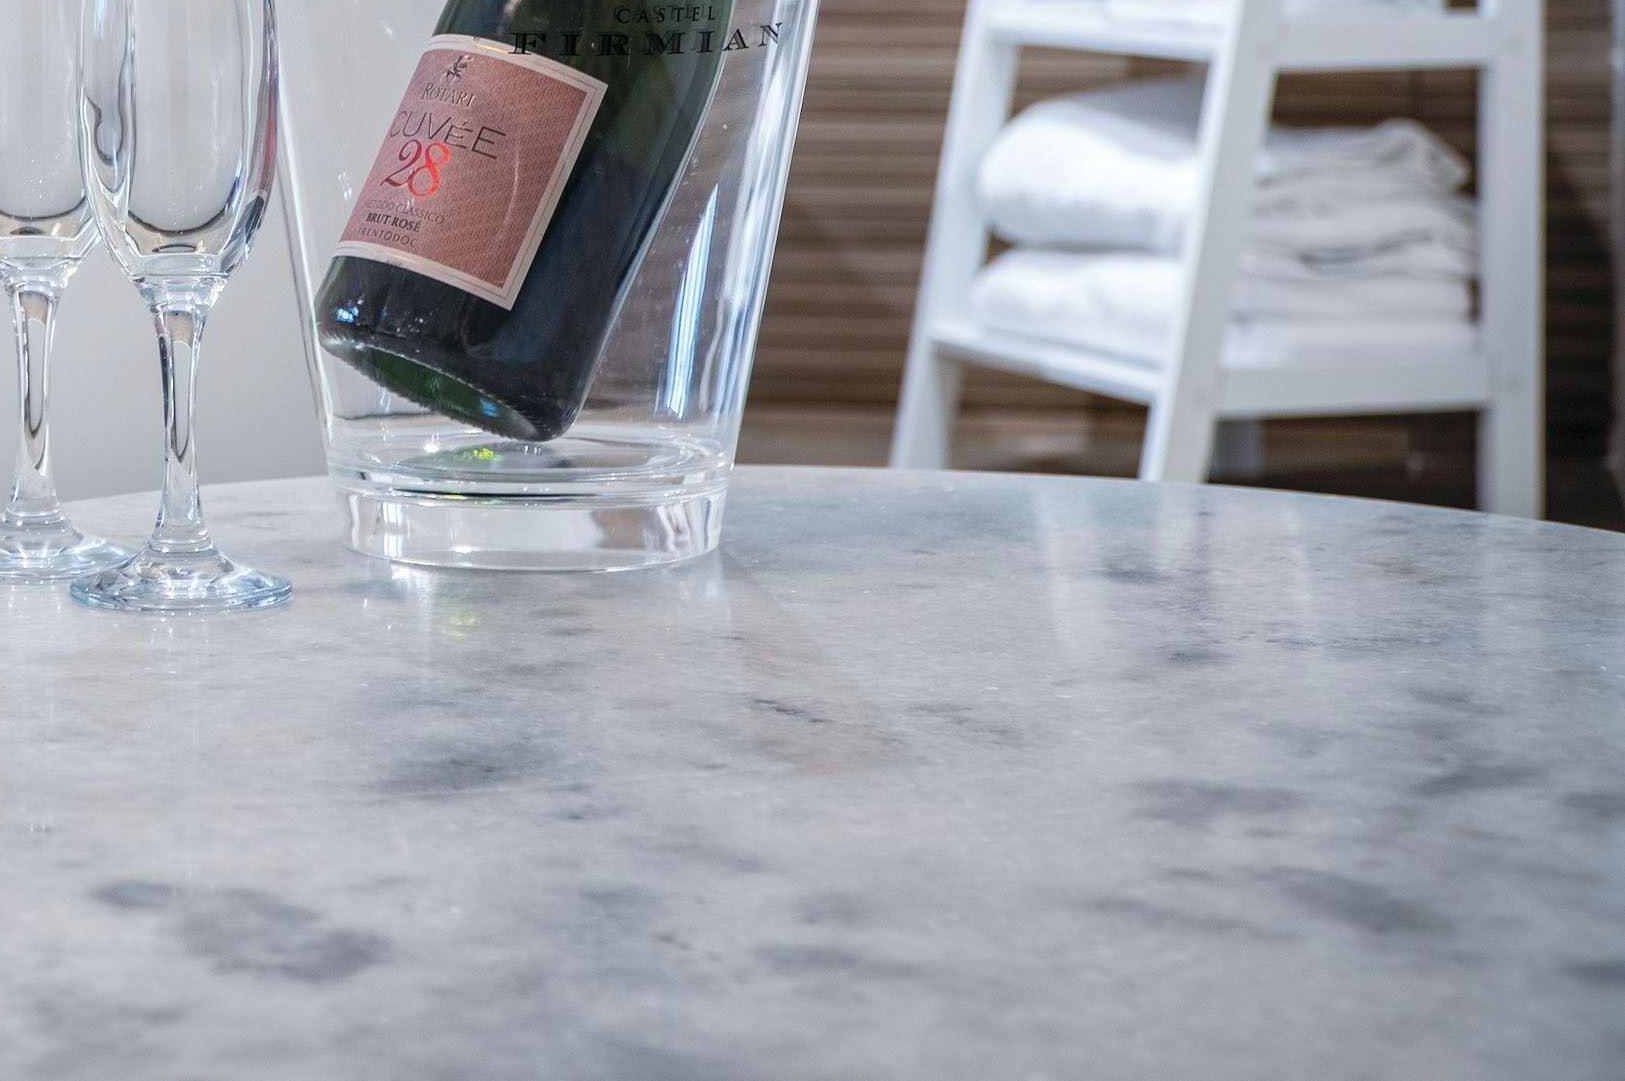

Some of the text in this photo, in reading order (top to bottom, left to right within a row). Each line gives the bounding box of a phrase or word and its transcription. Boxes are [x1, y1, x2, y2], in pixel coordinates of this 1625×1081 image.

[614, 3, 716, 24] CASTEL
[508, 22, 783, 57] FIRMIAN
[421, 82, 475, 107] ROTARI
[390, 110, 506, 160] CUVÉE
[380, 139, 450, 198] 28
[366, 212, 422, 233] BRUT ROSÉ
[396, 202, 445, 225] CLASSICO
[358, 227, 418, 248] TRENTODOC
